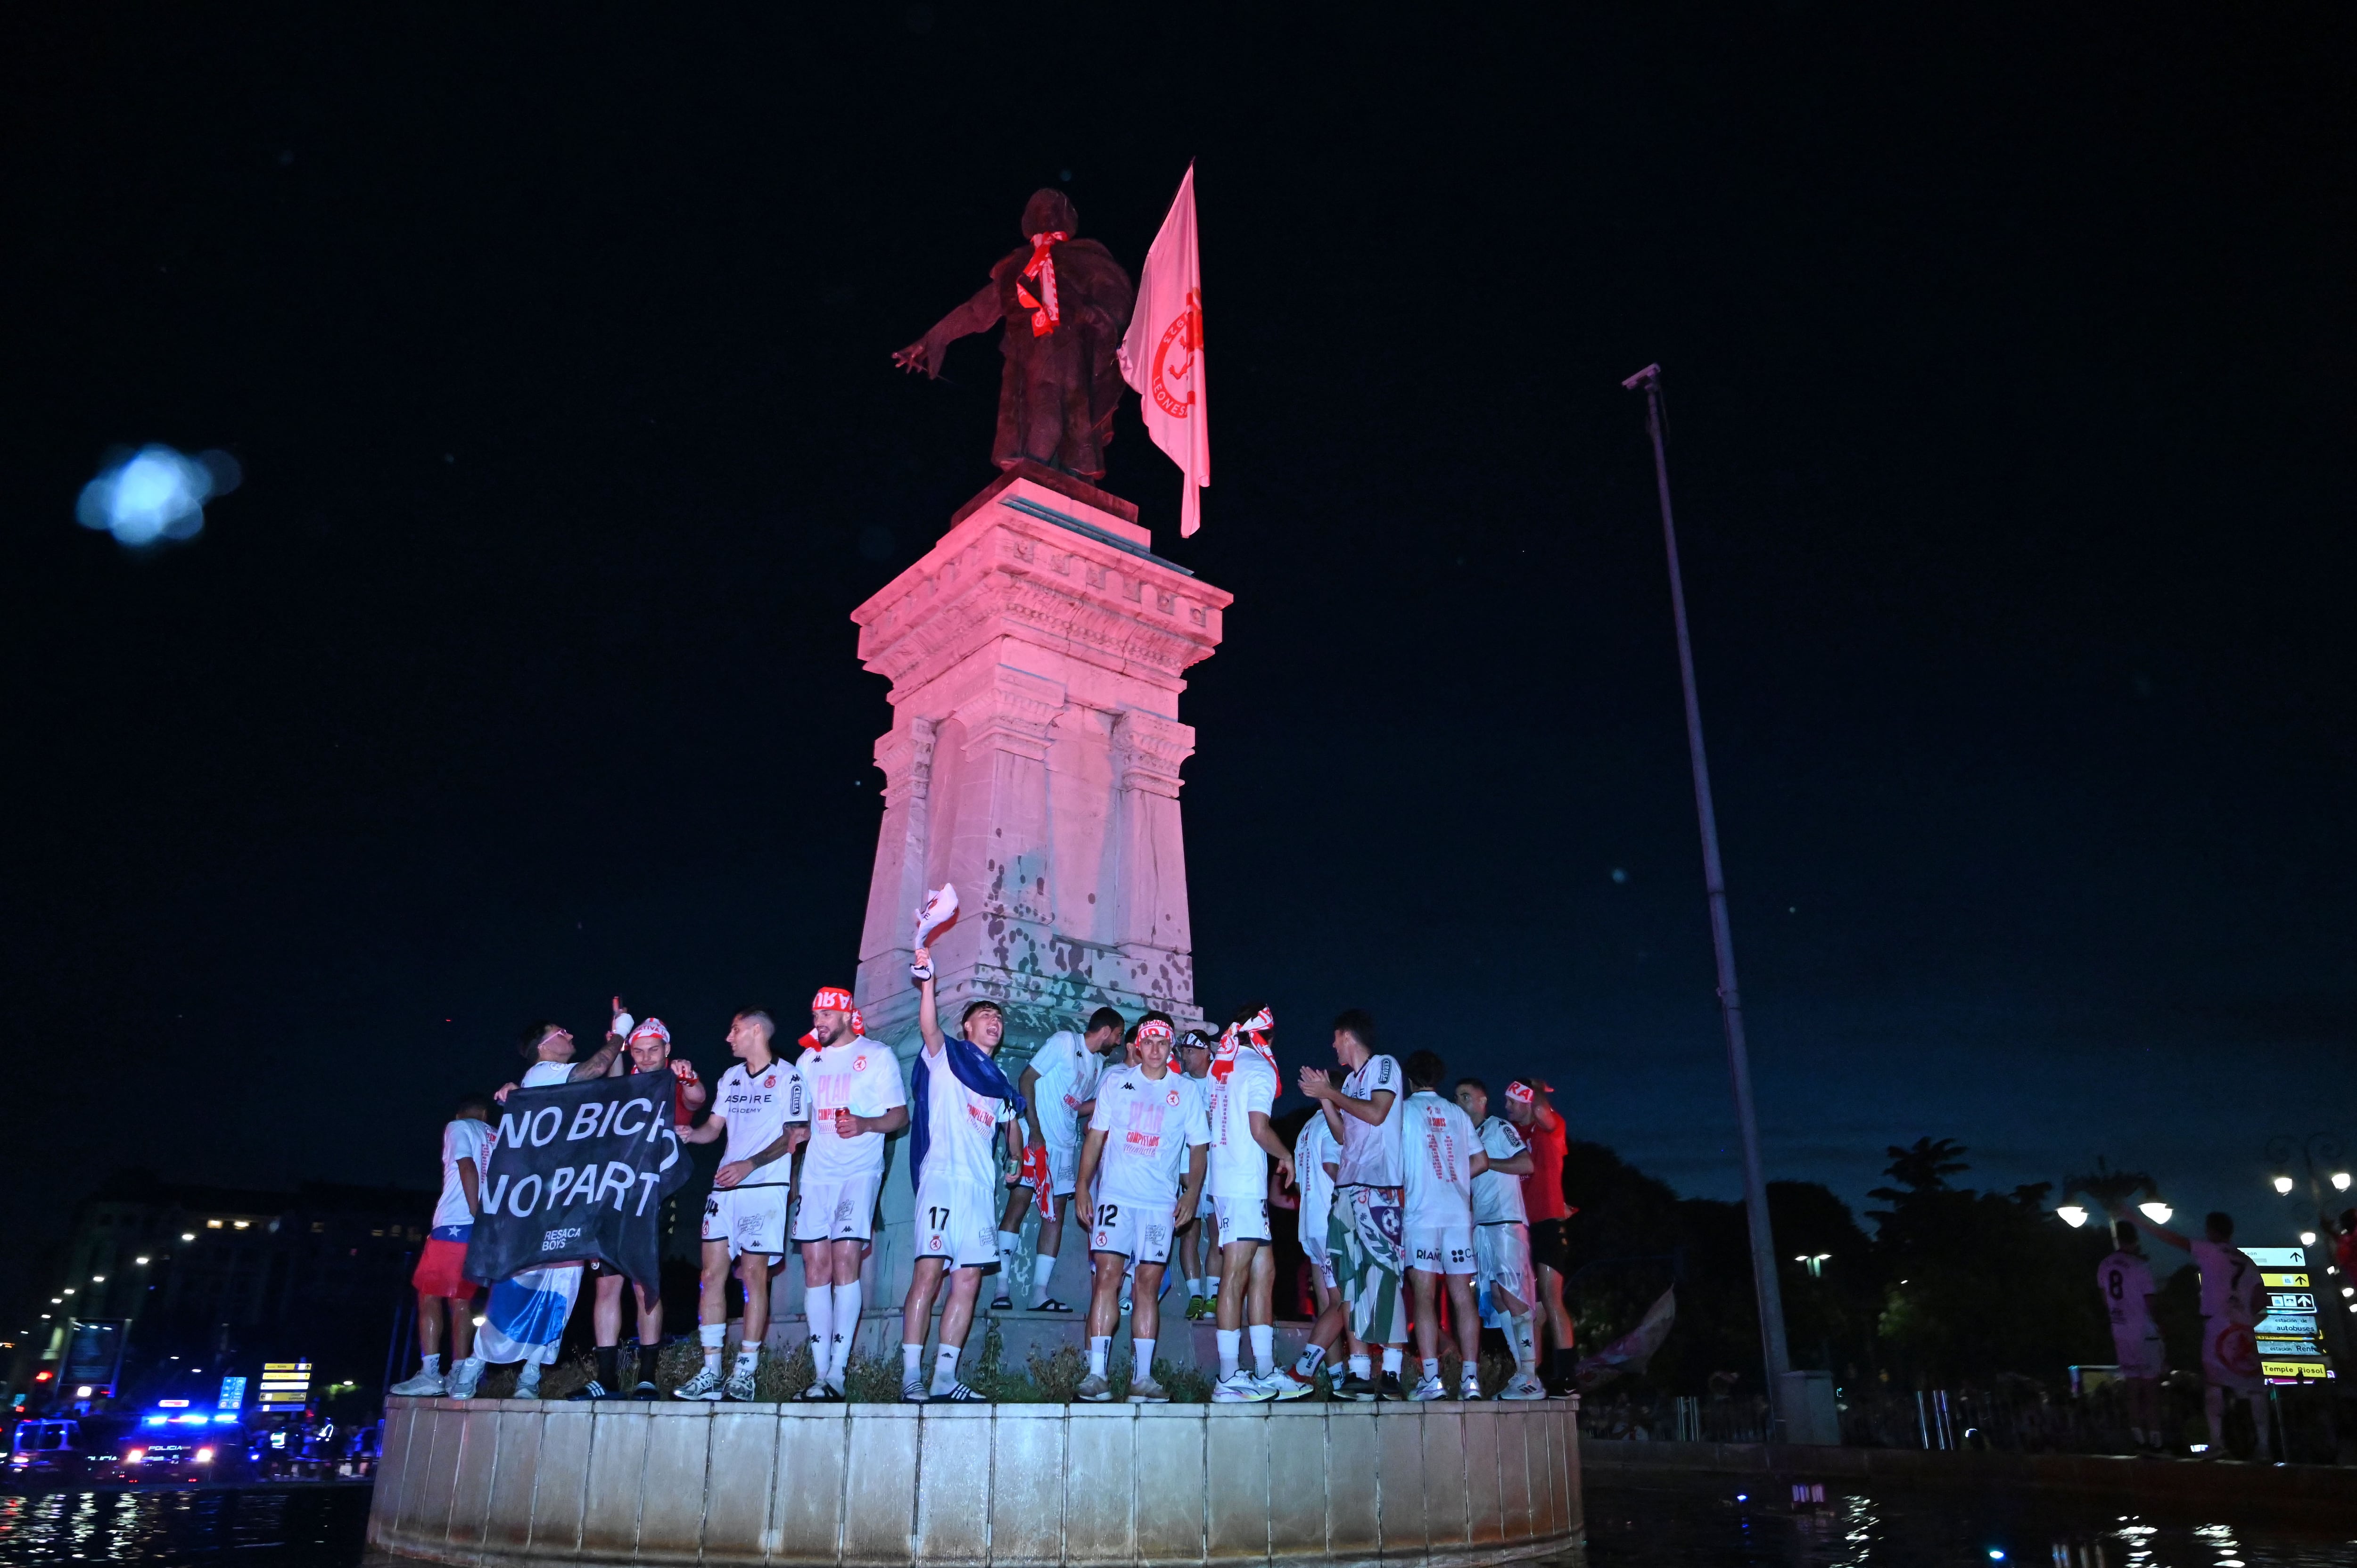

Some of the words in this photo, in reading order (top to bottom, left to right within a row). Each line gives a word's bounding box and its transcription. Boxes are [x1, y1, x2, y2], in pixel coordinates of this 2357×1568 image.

[725, 1094, 772, 1104] ASPIRE
[494, 1106, 562, 1149] NO
[929, 1207, 950, 1231] 17
[1098, 1204, 1118, 1228] 12
[544, 1228, 581, 1240] RESACA
[542, 1238, 566, 1251] BOYS
[2109, 1270, 2124, 1299] 8
[2264, 1365, 2293, 1373] Temple
